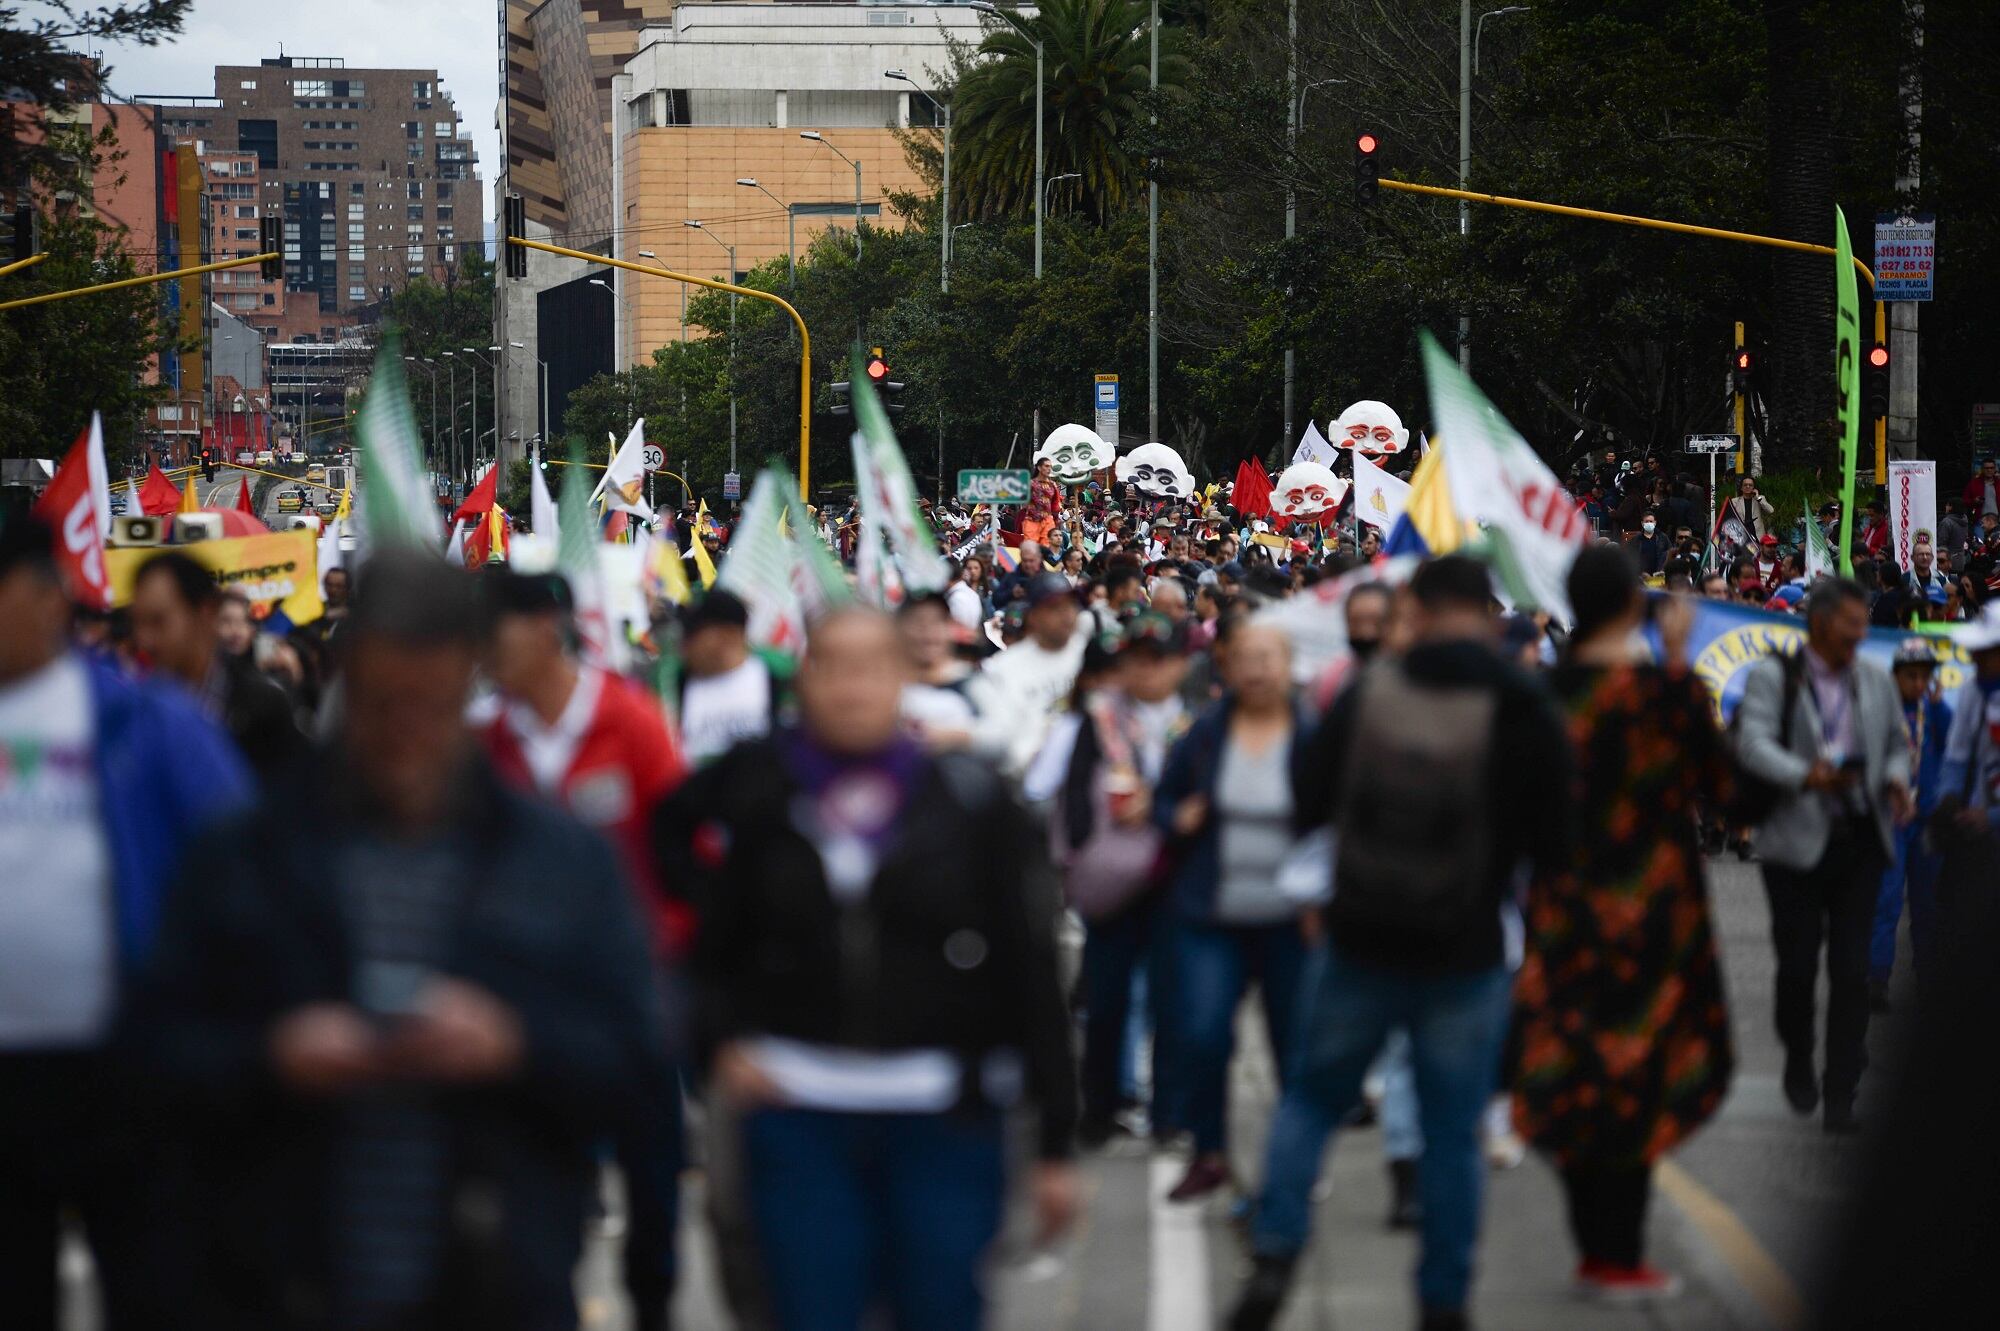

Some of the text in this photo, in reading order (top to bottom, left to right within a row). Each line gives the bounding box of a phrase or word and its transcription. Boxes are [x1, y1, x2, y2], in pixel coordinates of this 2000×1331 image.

[1876, 230, 1887, 240] SOLO
[1888, 230, 1905, 240] TECHOS
[1880, 246, 1933, 257] 313 812 73 33
[1881, 261, 1932, 271] 627 85 62
[1879, 280, 1928, 289] TECHOS PLACAS
[643, 450, 662, 465] 30
